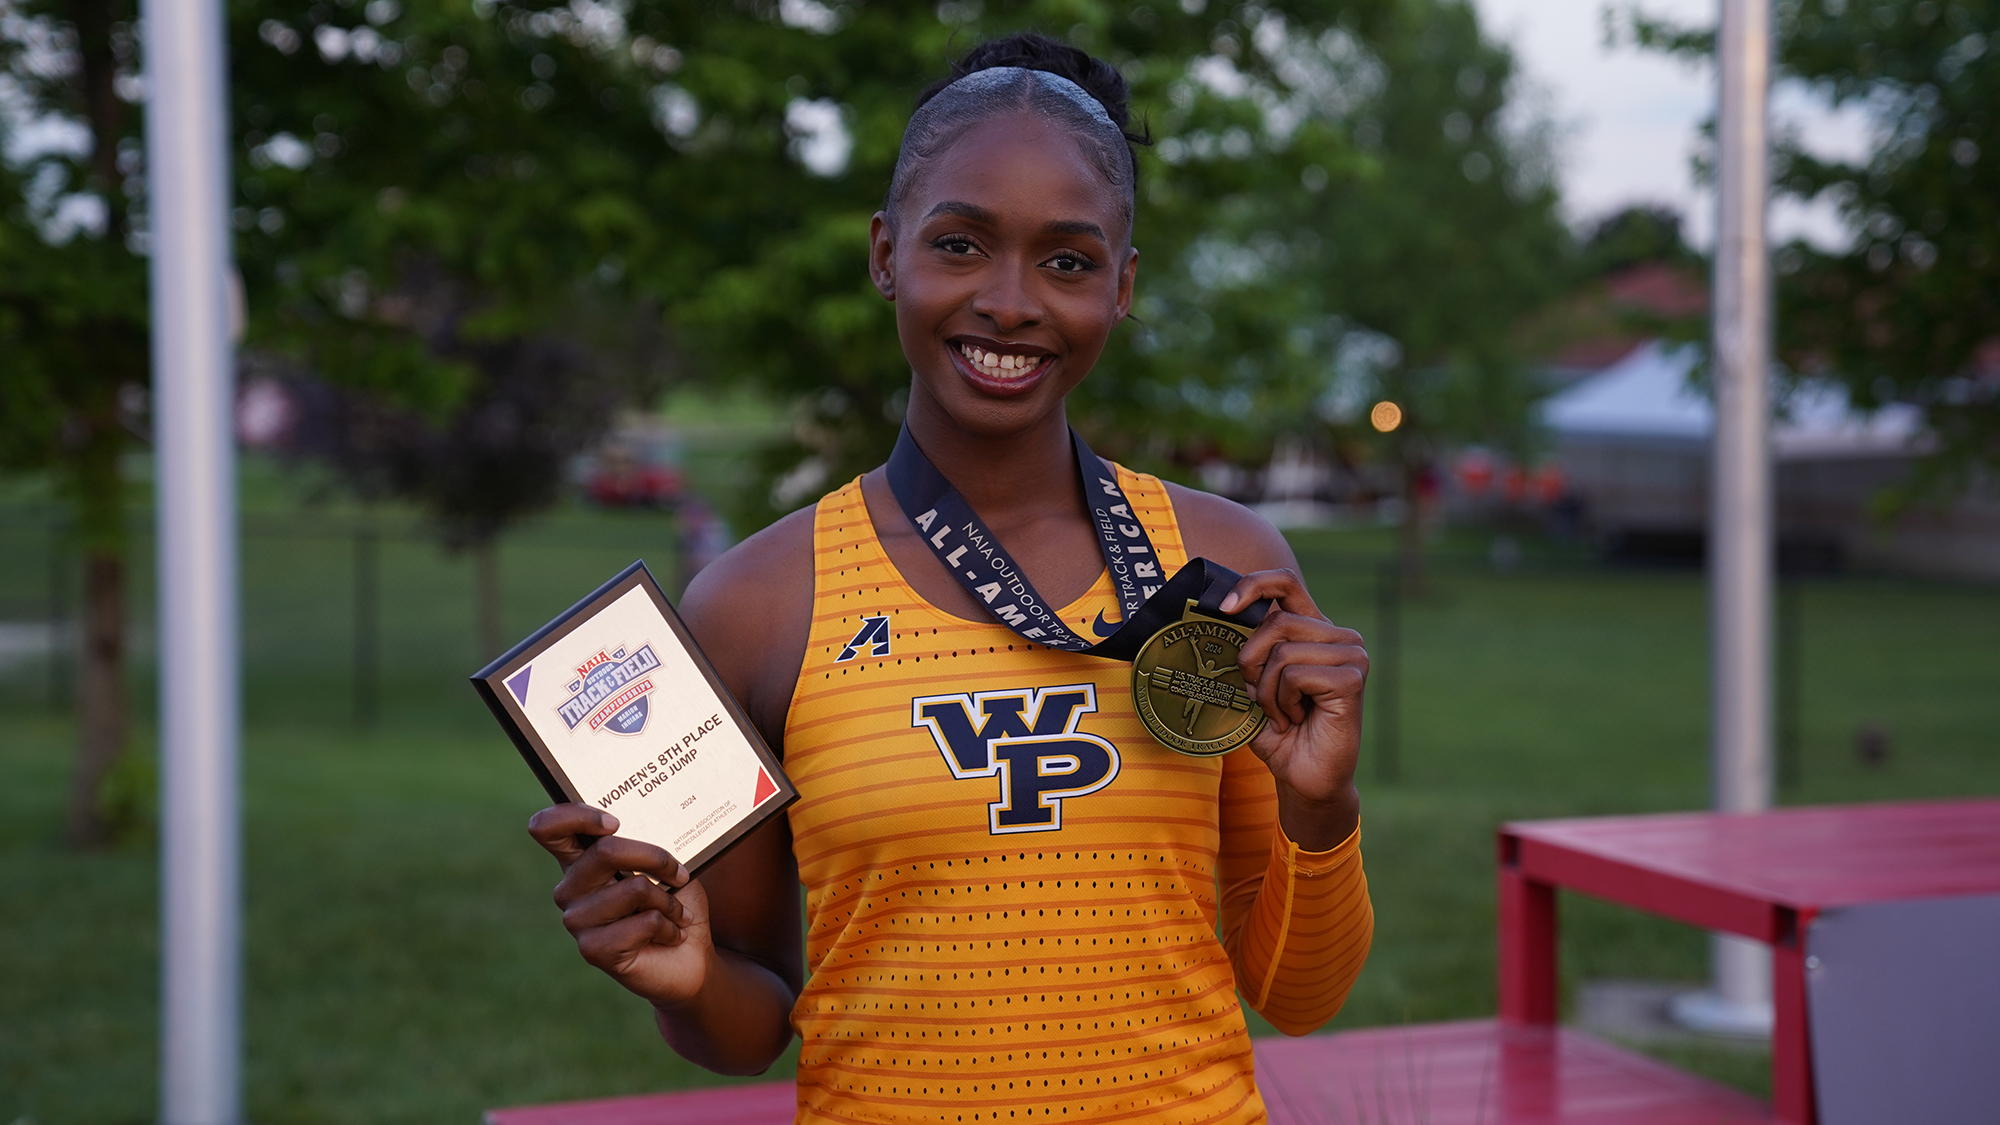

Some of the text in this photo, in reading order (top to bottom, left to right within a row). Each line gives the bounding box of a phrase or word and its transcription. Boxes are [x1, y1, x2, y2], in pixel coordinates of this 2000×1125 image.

[1095, 508, 1117, 542] FIELD
[1109, 544, 1121, 554] &
[962, 522, 1093, 648] NAIA OUTDOOR TRACK
[1113, 556, 1137, 599] TRACK
[1204, 643, 1222, 654] 2024
[577, 651, 611, 680] NAIA
[587, 663, 615, 685] OUTDOOR
[559, 647, 658, 726] TRACK & FIELD
[1180, 680, 1200, 692] CROSS
[1201, 684, 1233, 701] COUNTRY
[1186, 674, 1208, 687] TRACK
[1209, 681, 1215, 689] &
[1216, 682, 1234, 694] FIELD
[1194, 690, 1230, 707] ASSOCIATION
[591, 680, 651, 728] CHAMPIONSHIPS
[617, 705, 638, 723] MARION
[1138, 685, 1258, 751] NAIA OUTDOOR TRACK & FIELD
[621, 711, 643, 729] INDIANA
[598, 713, 723, 808] WOMEN'S 8TH PLACE
[638, 749, 698, 798] LONG JUMP
[680, 795, 697, 810] 2024
[673, 800, 731, 846] NATIONAL ASSOCIATION OF
[675, 804, 737, 853] INTERCOLLEGIATE ATHLETICS
